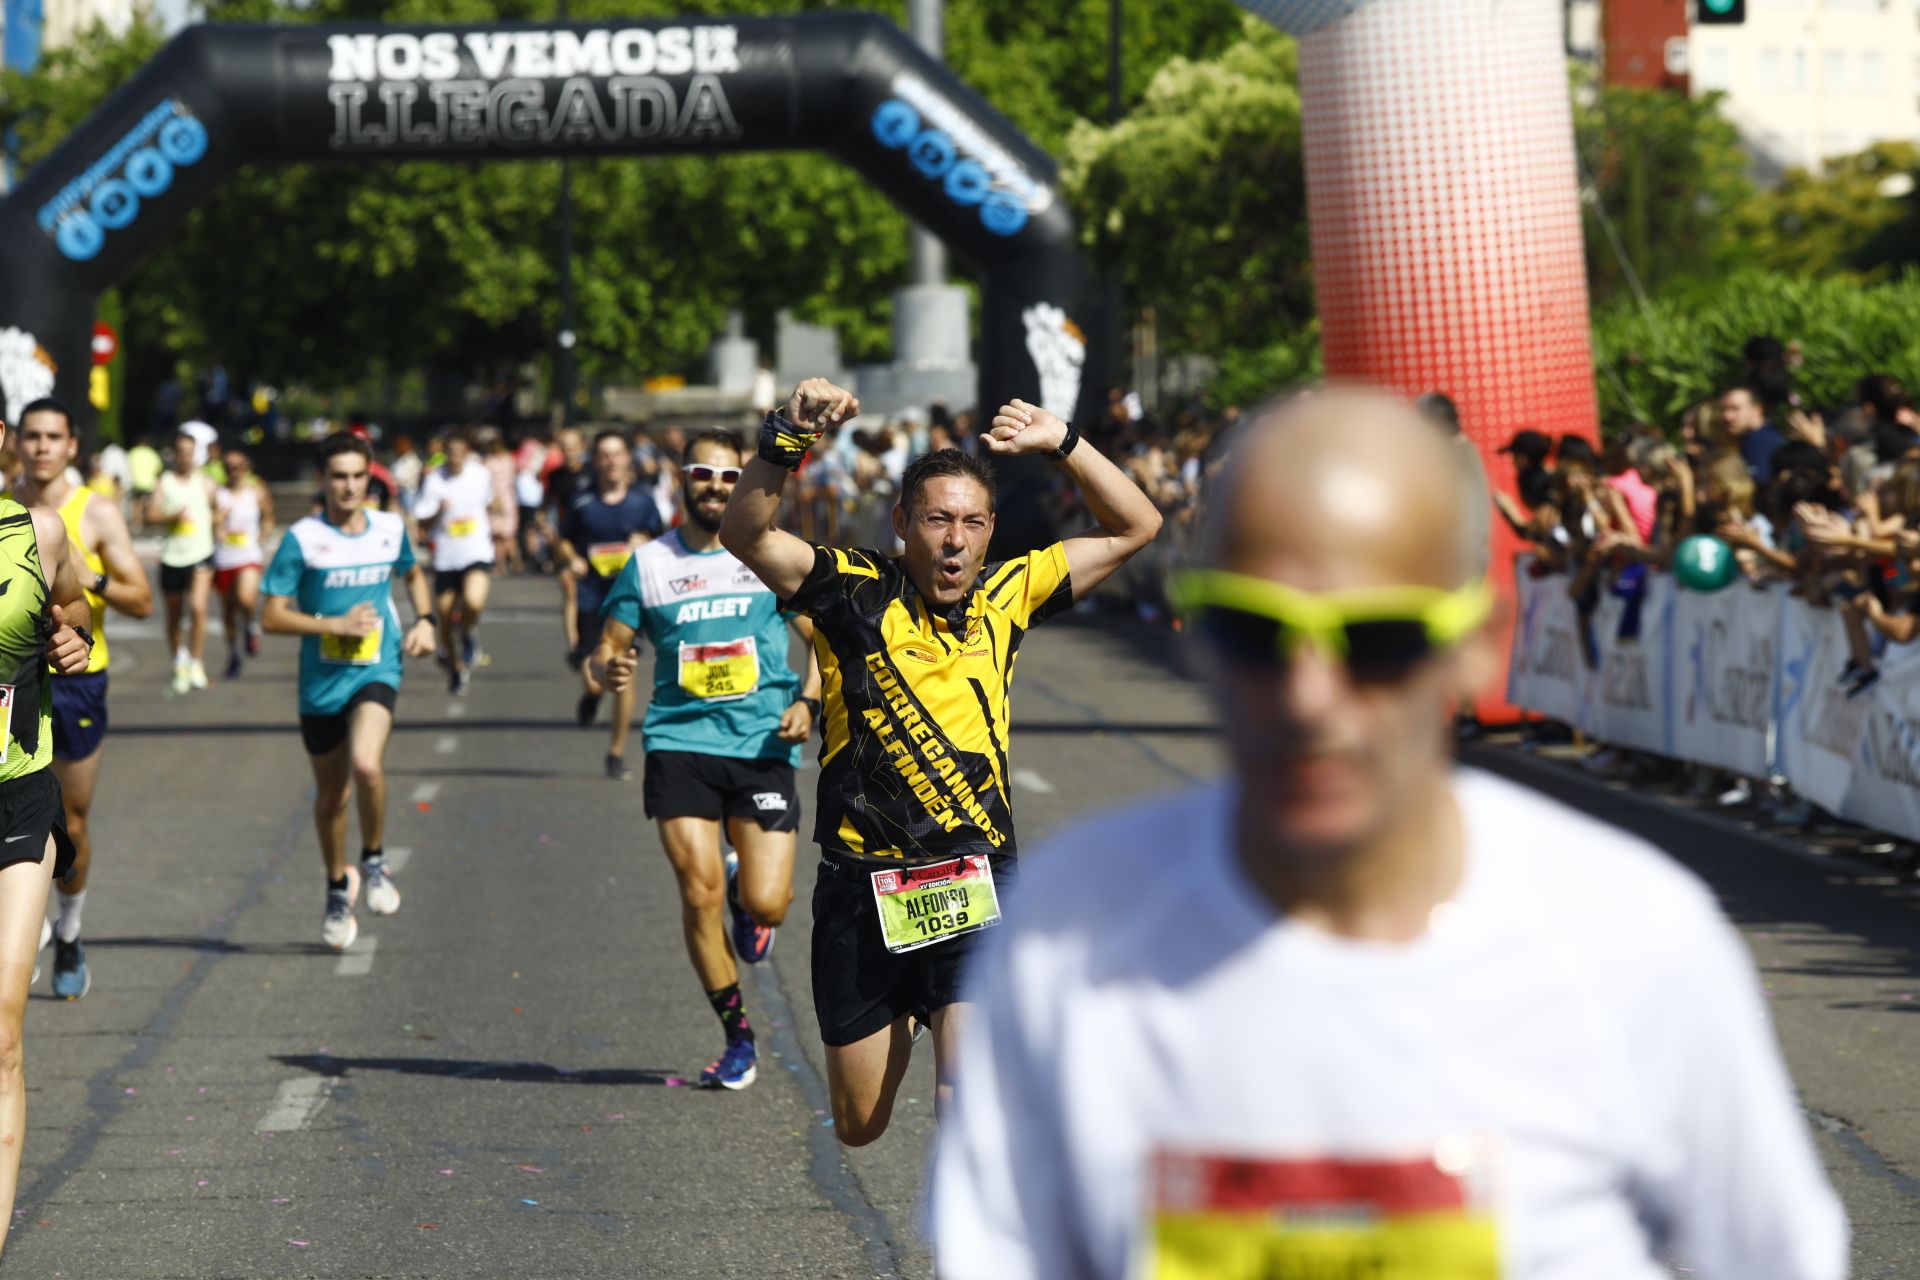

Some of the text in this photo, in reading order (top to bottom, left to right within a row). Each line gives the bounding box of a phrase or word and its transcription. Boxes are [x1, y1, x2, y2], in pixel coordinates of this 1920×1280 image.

[328, 27, 693, 82] NOS VEMOS
[328, 75, 743, 150] LLEGADA
[324, 564, 393, 588] ATLEET
[676, 596, 753, 624] ATLEET
[705, 679, 735, 694] 245
[862, 707, 963, 833] ALFINDÉN
[906, 887, 970, 920] ALFONSO
[914, 911, 969, 936] 1039
